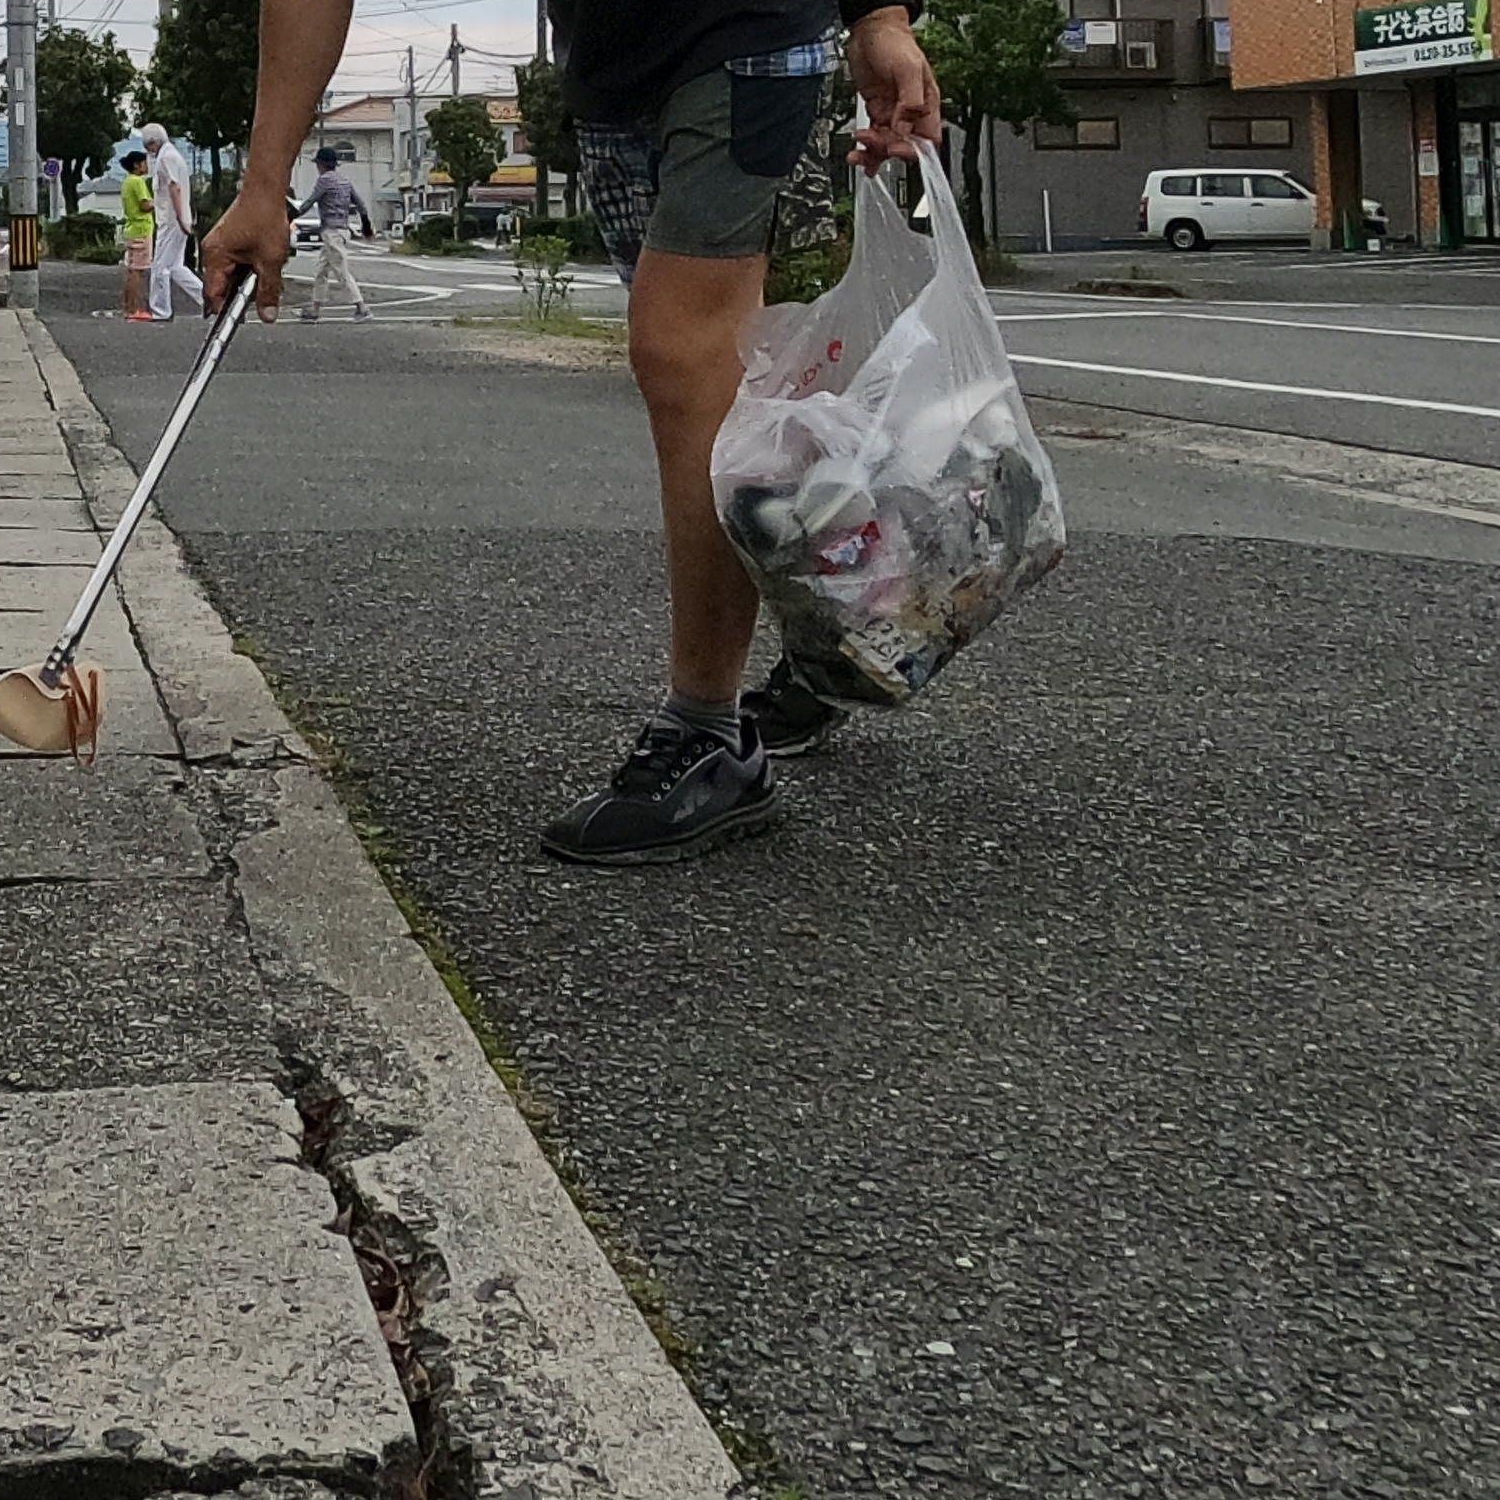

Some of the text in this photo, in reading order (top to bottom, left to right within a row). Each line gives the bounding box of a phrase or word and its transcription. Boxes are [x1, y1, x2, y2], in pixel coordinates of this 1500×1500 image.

[1373, 1, 1466, 44] 子ども英会話
